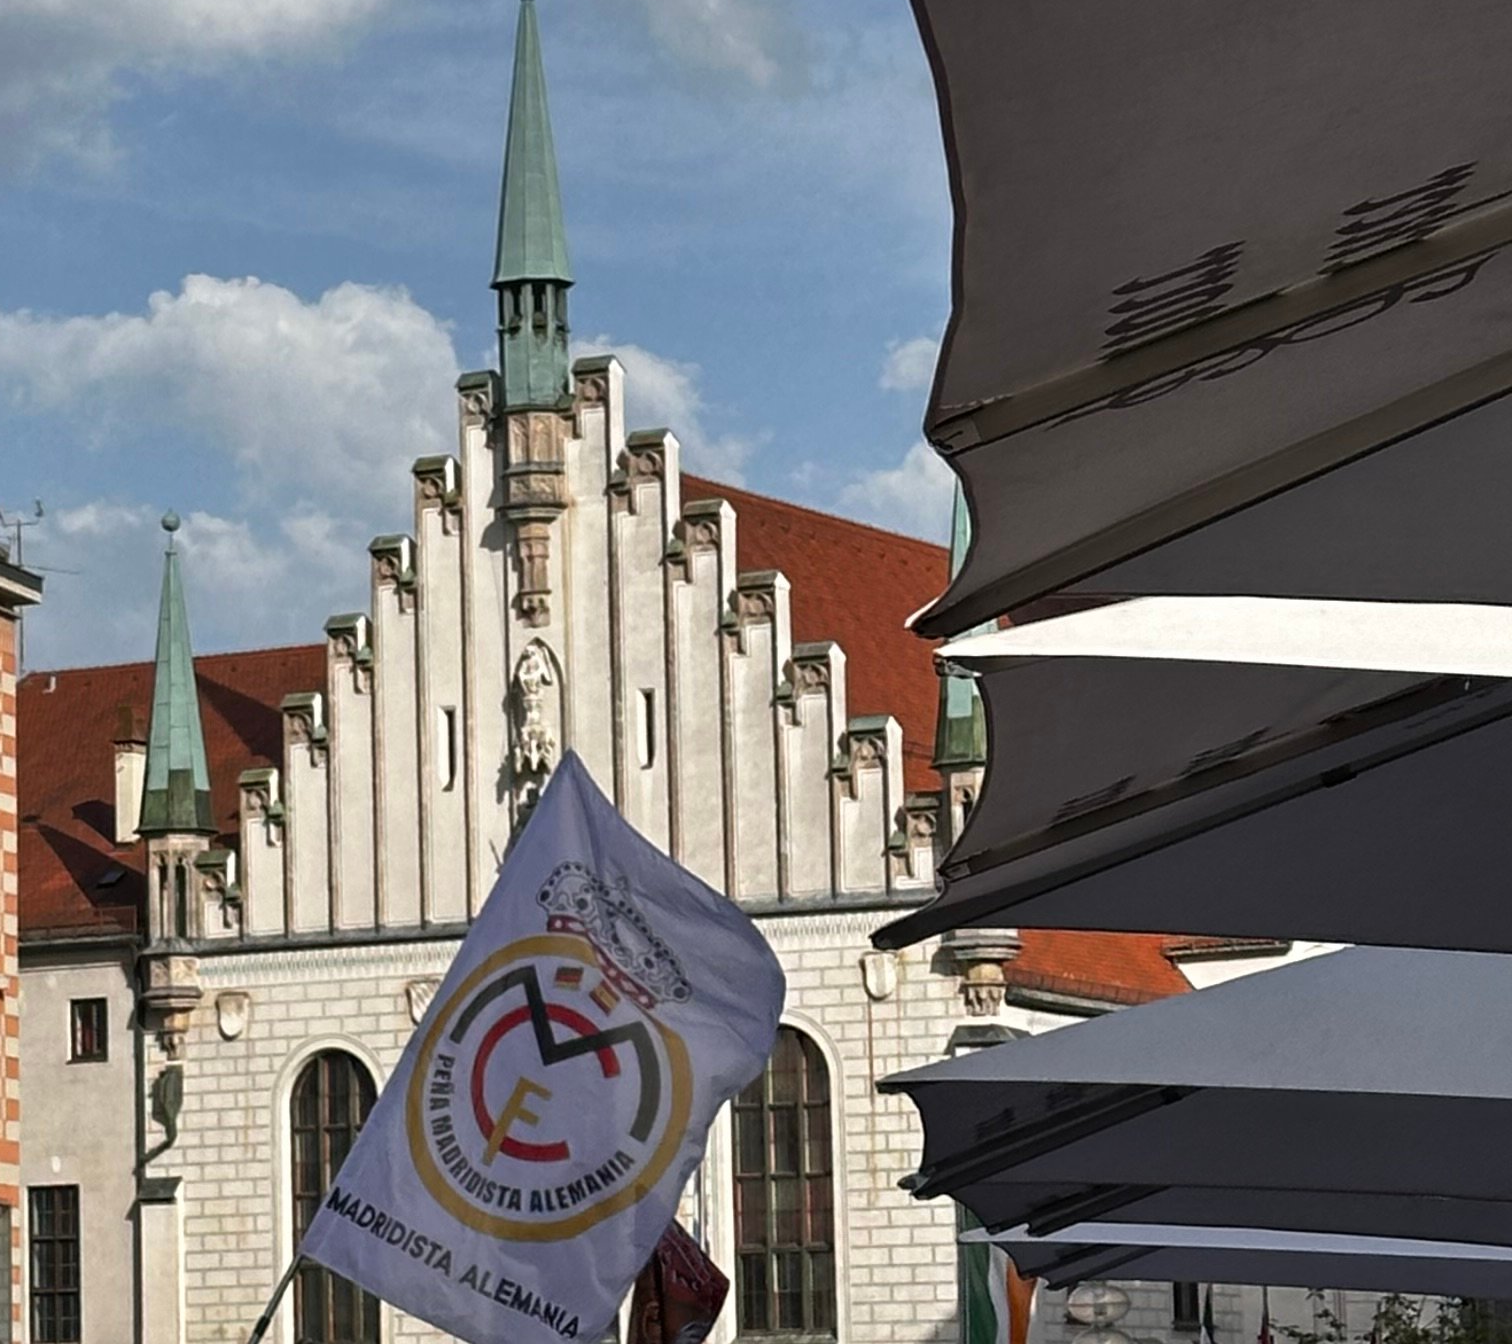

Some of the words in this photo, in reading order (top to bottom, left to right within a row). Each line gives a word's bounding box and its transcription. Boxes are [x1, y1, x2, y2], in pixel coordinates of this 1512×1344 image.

[430, 1114, 522, 1212] MADRIDISTA
[529, 1150, 636, 1213] ALEMANIA
[325, 1186, 451, 1277] MADRIDISTA
[458, 1264, 580, 1339] ALEMANIA
